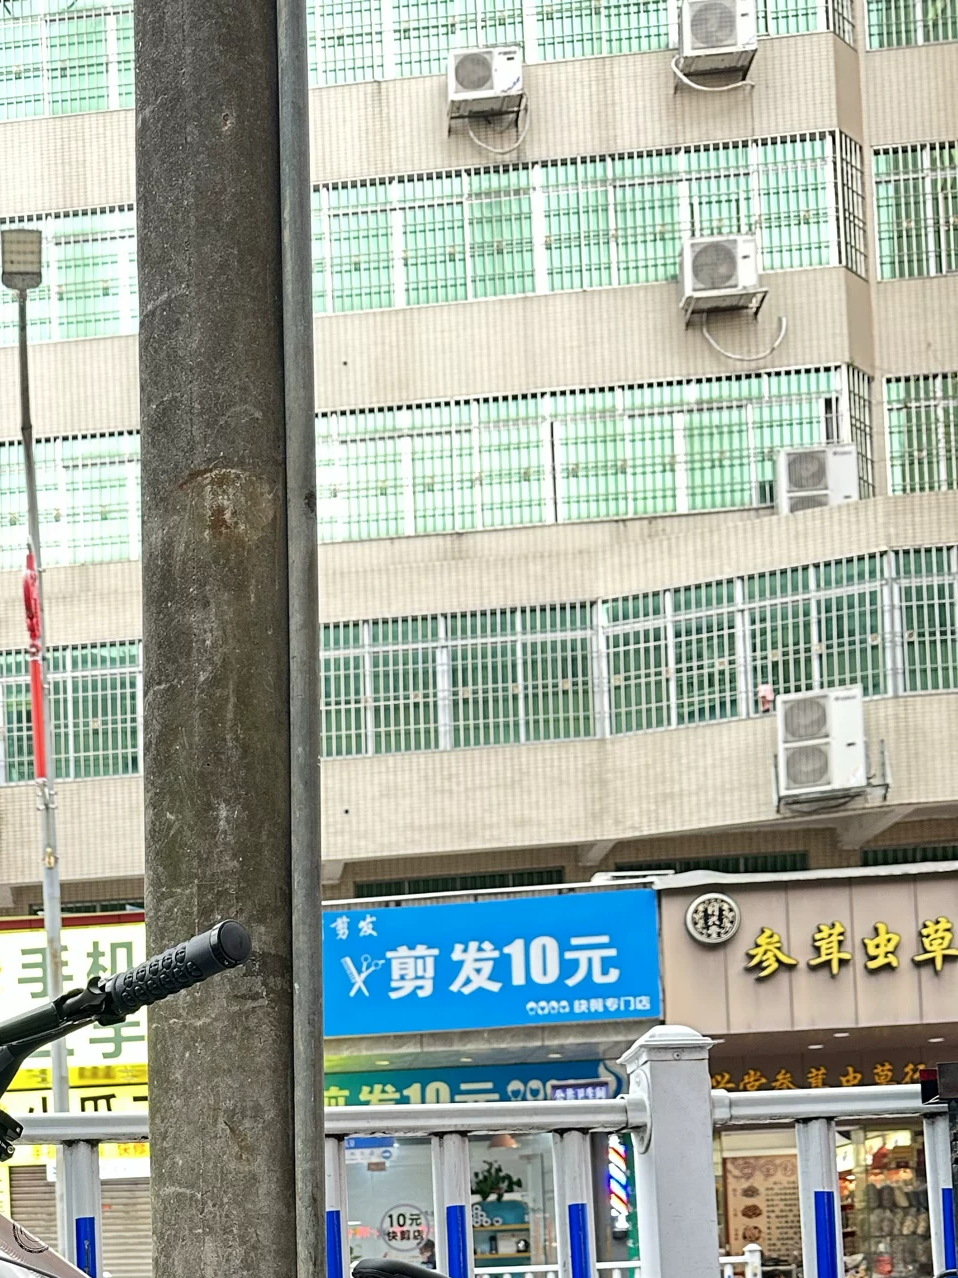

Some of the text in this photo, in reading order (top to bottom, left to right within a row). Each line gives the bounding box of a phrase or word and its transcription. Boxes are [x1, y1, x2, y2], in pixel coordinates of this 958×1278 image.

[18, 941, 134, 999] 手机
[385, 934, 621, 1000] 剪发10元
[744, 916, 958, 980] 参茸虫草
[386, 1229, 425, 1242] 快剪店
[387, 1213, 422, 1228] 10元
